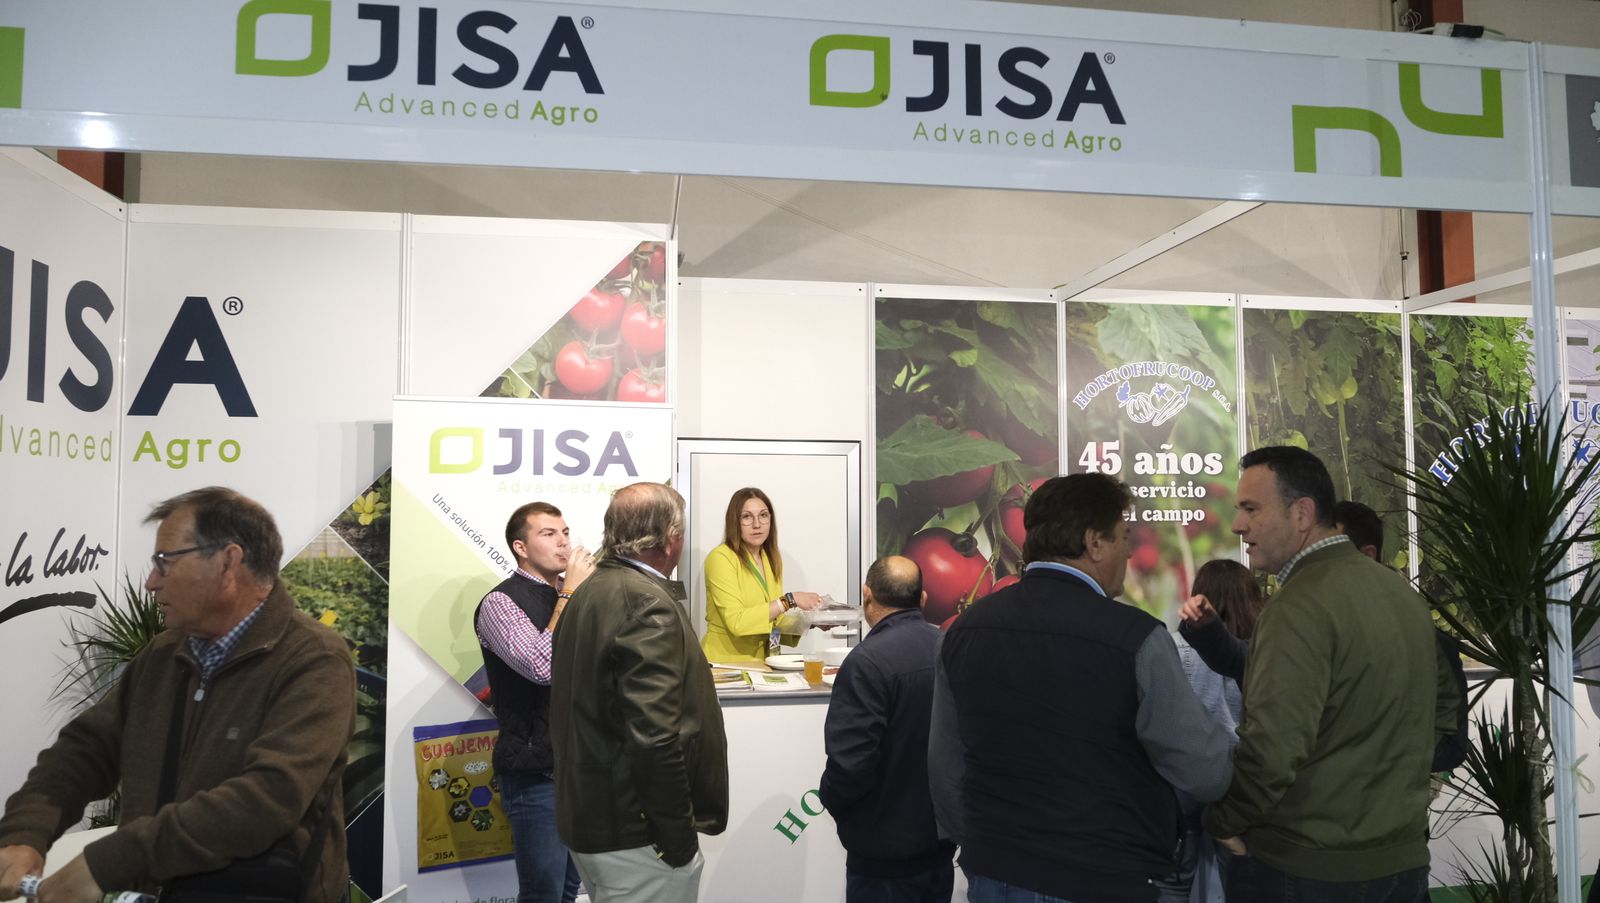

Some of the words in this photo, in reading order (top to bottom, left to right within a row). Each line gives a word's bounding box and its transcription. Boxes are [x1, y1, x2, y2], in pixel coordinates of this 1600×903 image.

[354, 91, 519, 120] Advanced
[530, 100, 599, 126] Agro
[913, 121, 1054, 148] Advanced
[1063, 130, 1122, 154] Agro
[1072, 361, 1216, 411] HORTOFRUCOOP
[132, 430, 242, 469] Agro
[1078, 440, 1122, 475] 45
[1133, 443, 1224, 475] años
[497, 481, 591, 494] Advanced
[1129, 481, 1207, 498] servicio
[432, 493, 451, 514] Una
[449, 512, 486, 549] solución
[486, 546, 510, 571] 100%
[1142, 508, 1206, 526] campo
[5, 531, 35, 588] la
[433, 850, 455, 861] JISA
